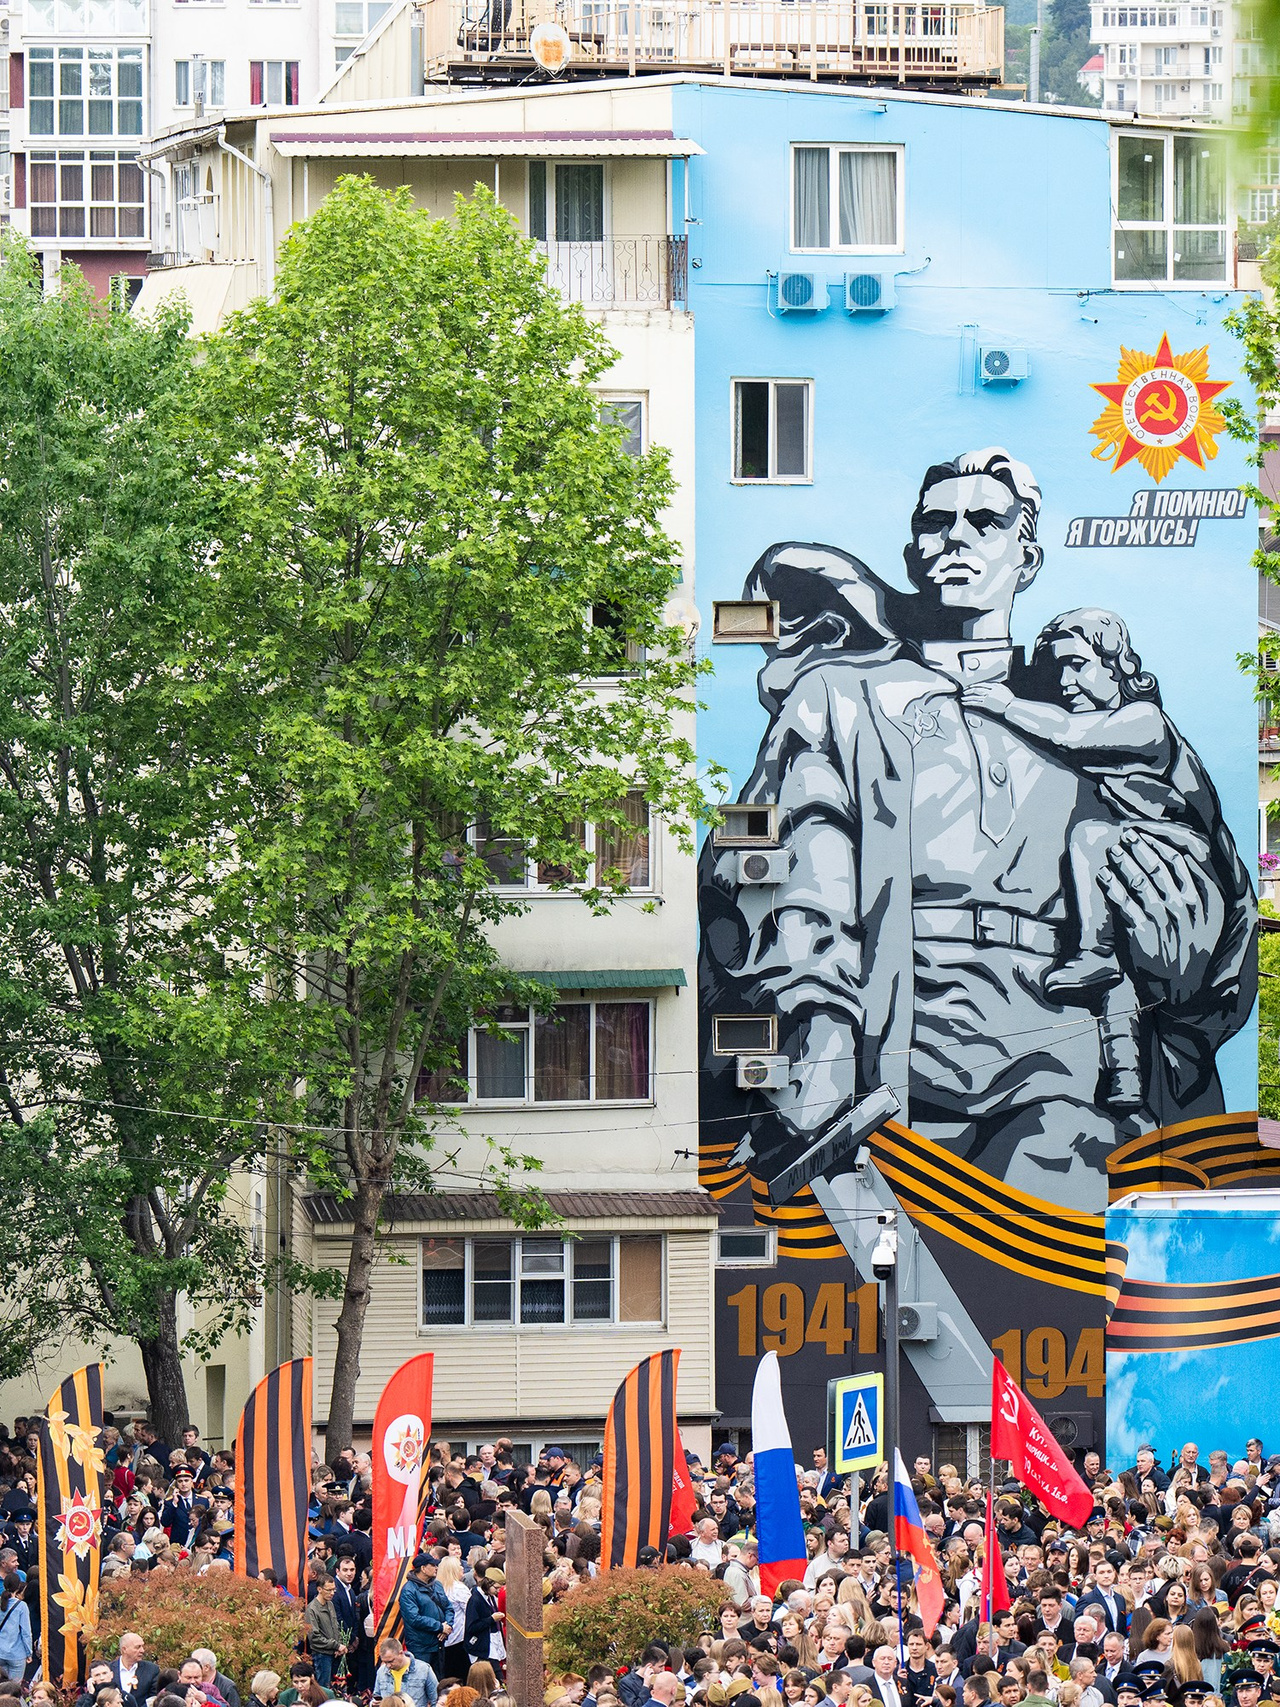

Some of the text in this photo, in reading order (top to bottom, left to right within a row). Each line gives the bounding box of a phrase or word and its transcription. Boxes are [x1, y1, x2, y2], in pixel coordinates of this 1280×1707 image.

[1125, 370, 1193, 439] ОТЕЧЕСТВЕННАЯ
[1066, 519, 1198, 546] Я ГОРЖУСЬ!
[1131, 491, 1248, 517] Я ПОМНЮ!
[727, 1282, 880, 1357] 1941
[991, 1327, 1107, 1399] 194
